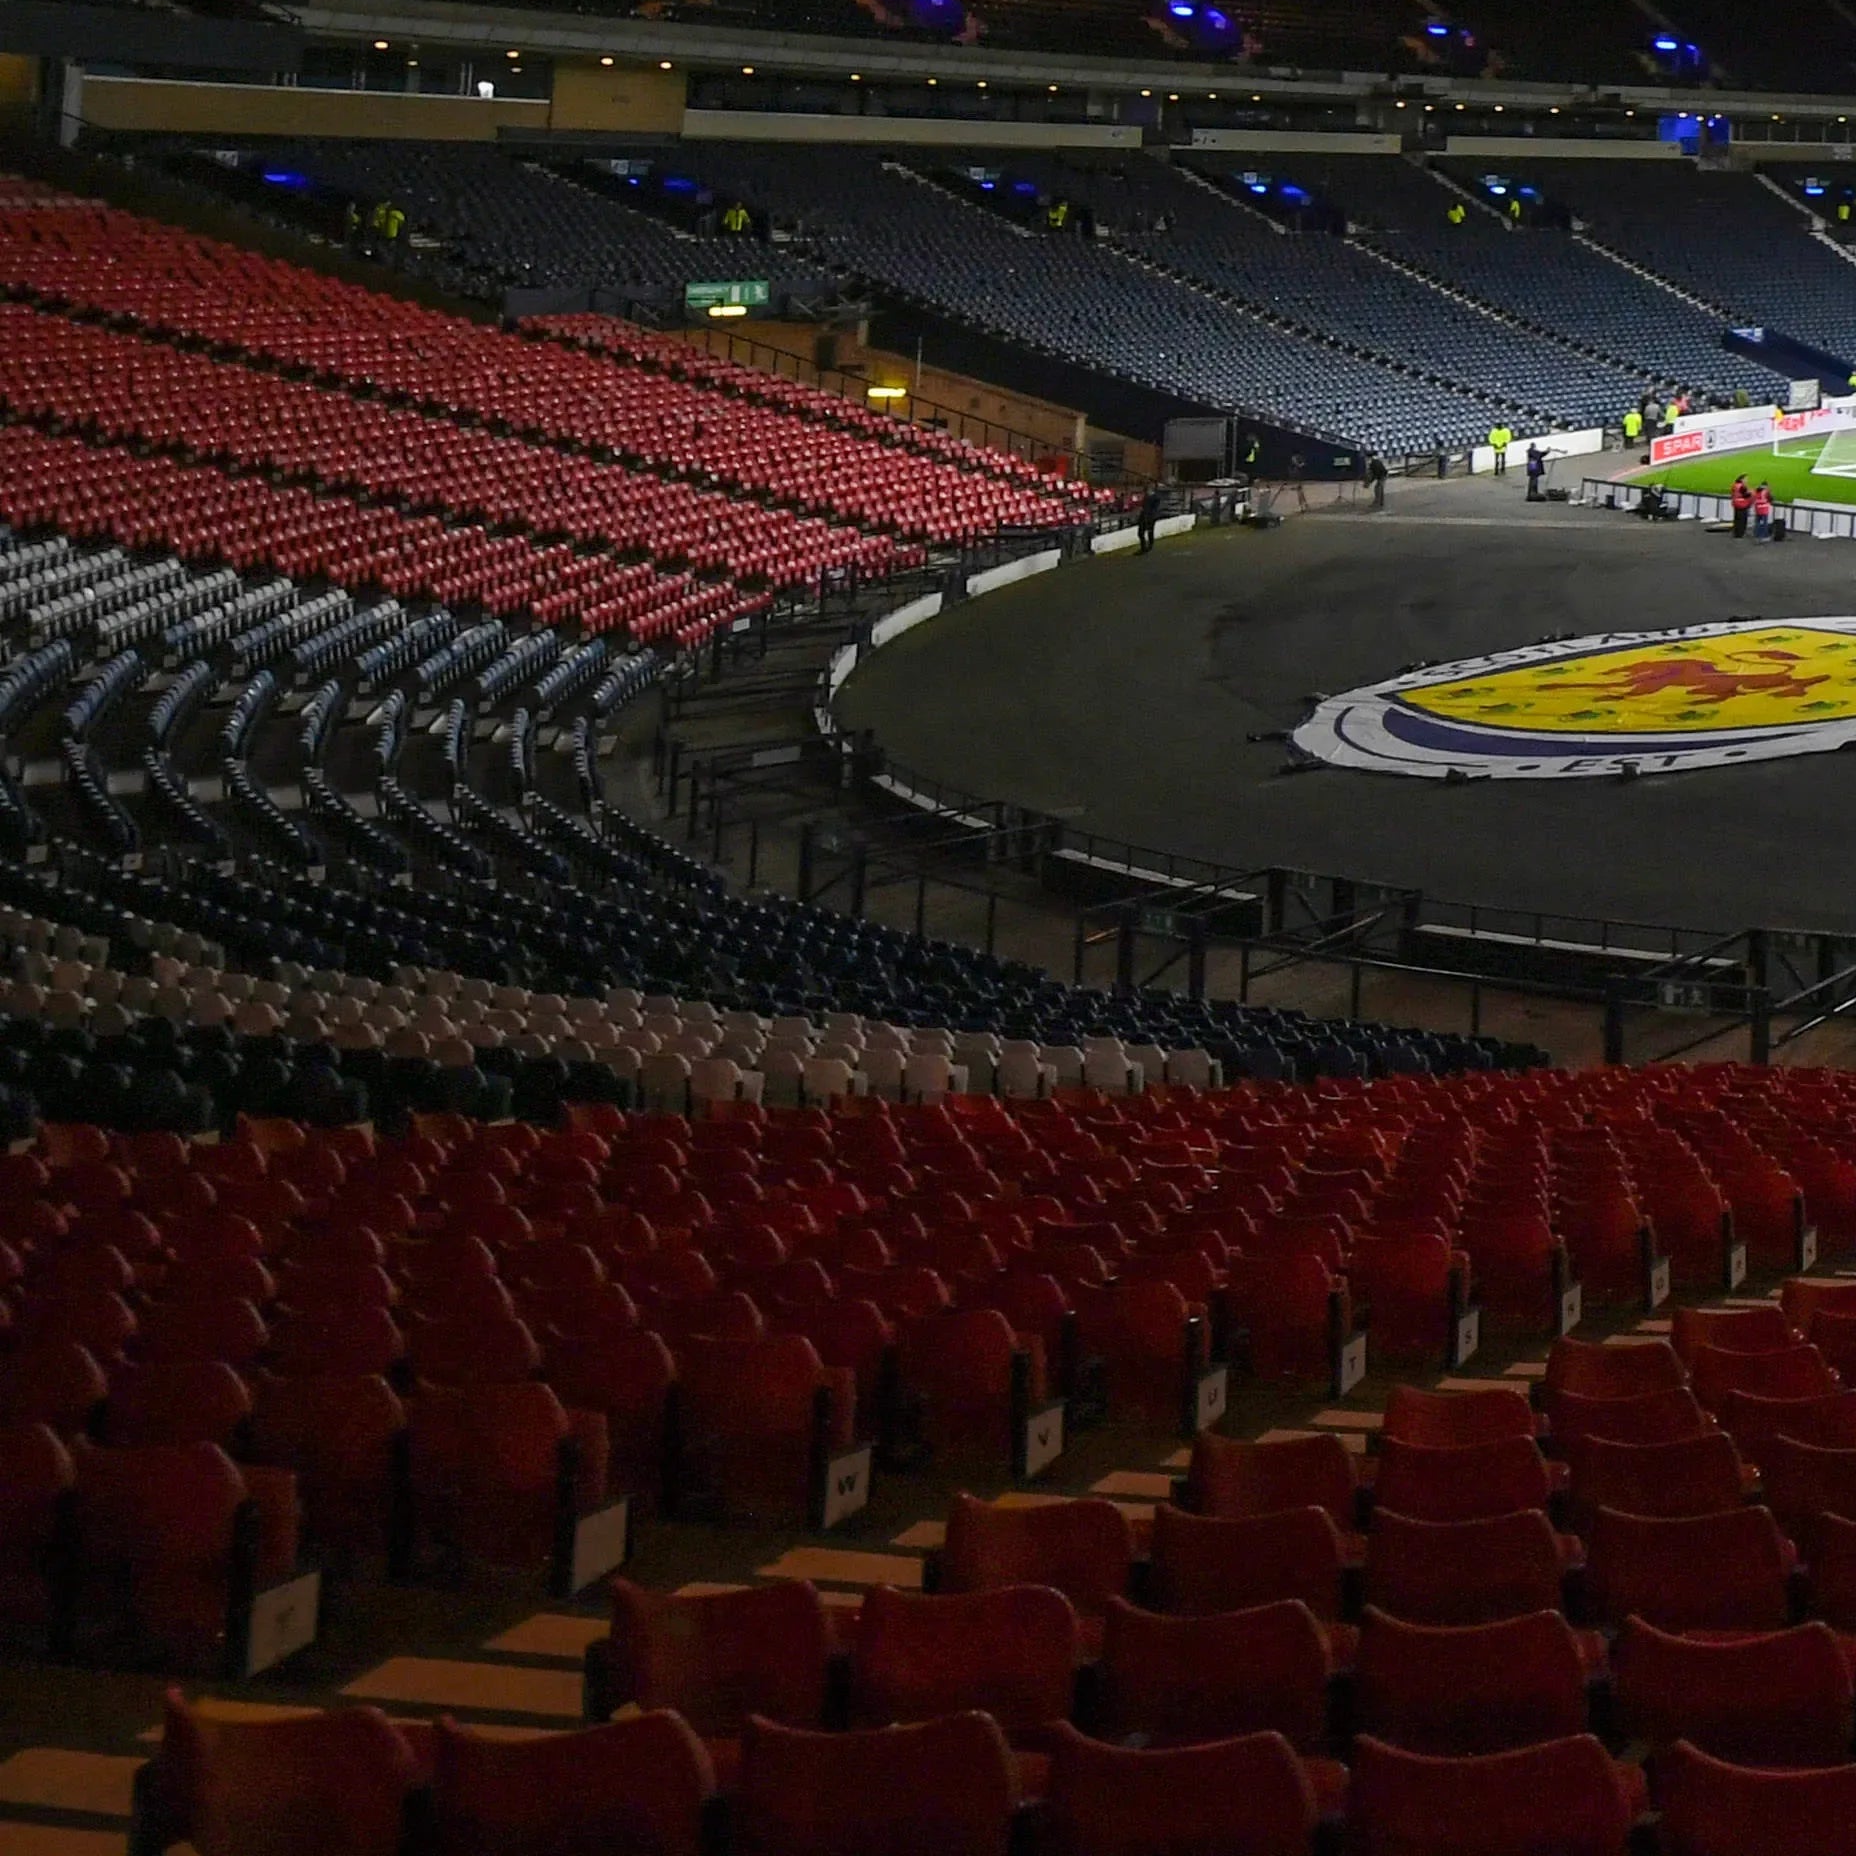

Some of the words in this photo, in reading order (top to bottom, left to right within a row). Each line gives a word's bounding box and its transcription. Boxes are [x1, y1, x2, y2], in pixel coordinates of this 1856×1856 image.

[1663, 433, 1703, 456] SPAR
[1559, 753, 1696, 773] EST
[1037, 1427, 1050, 1447] V
[838, 1471, 859, 1495] W
